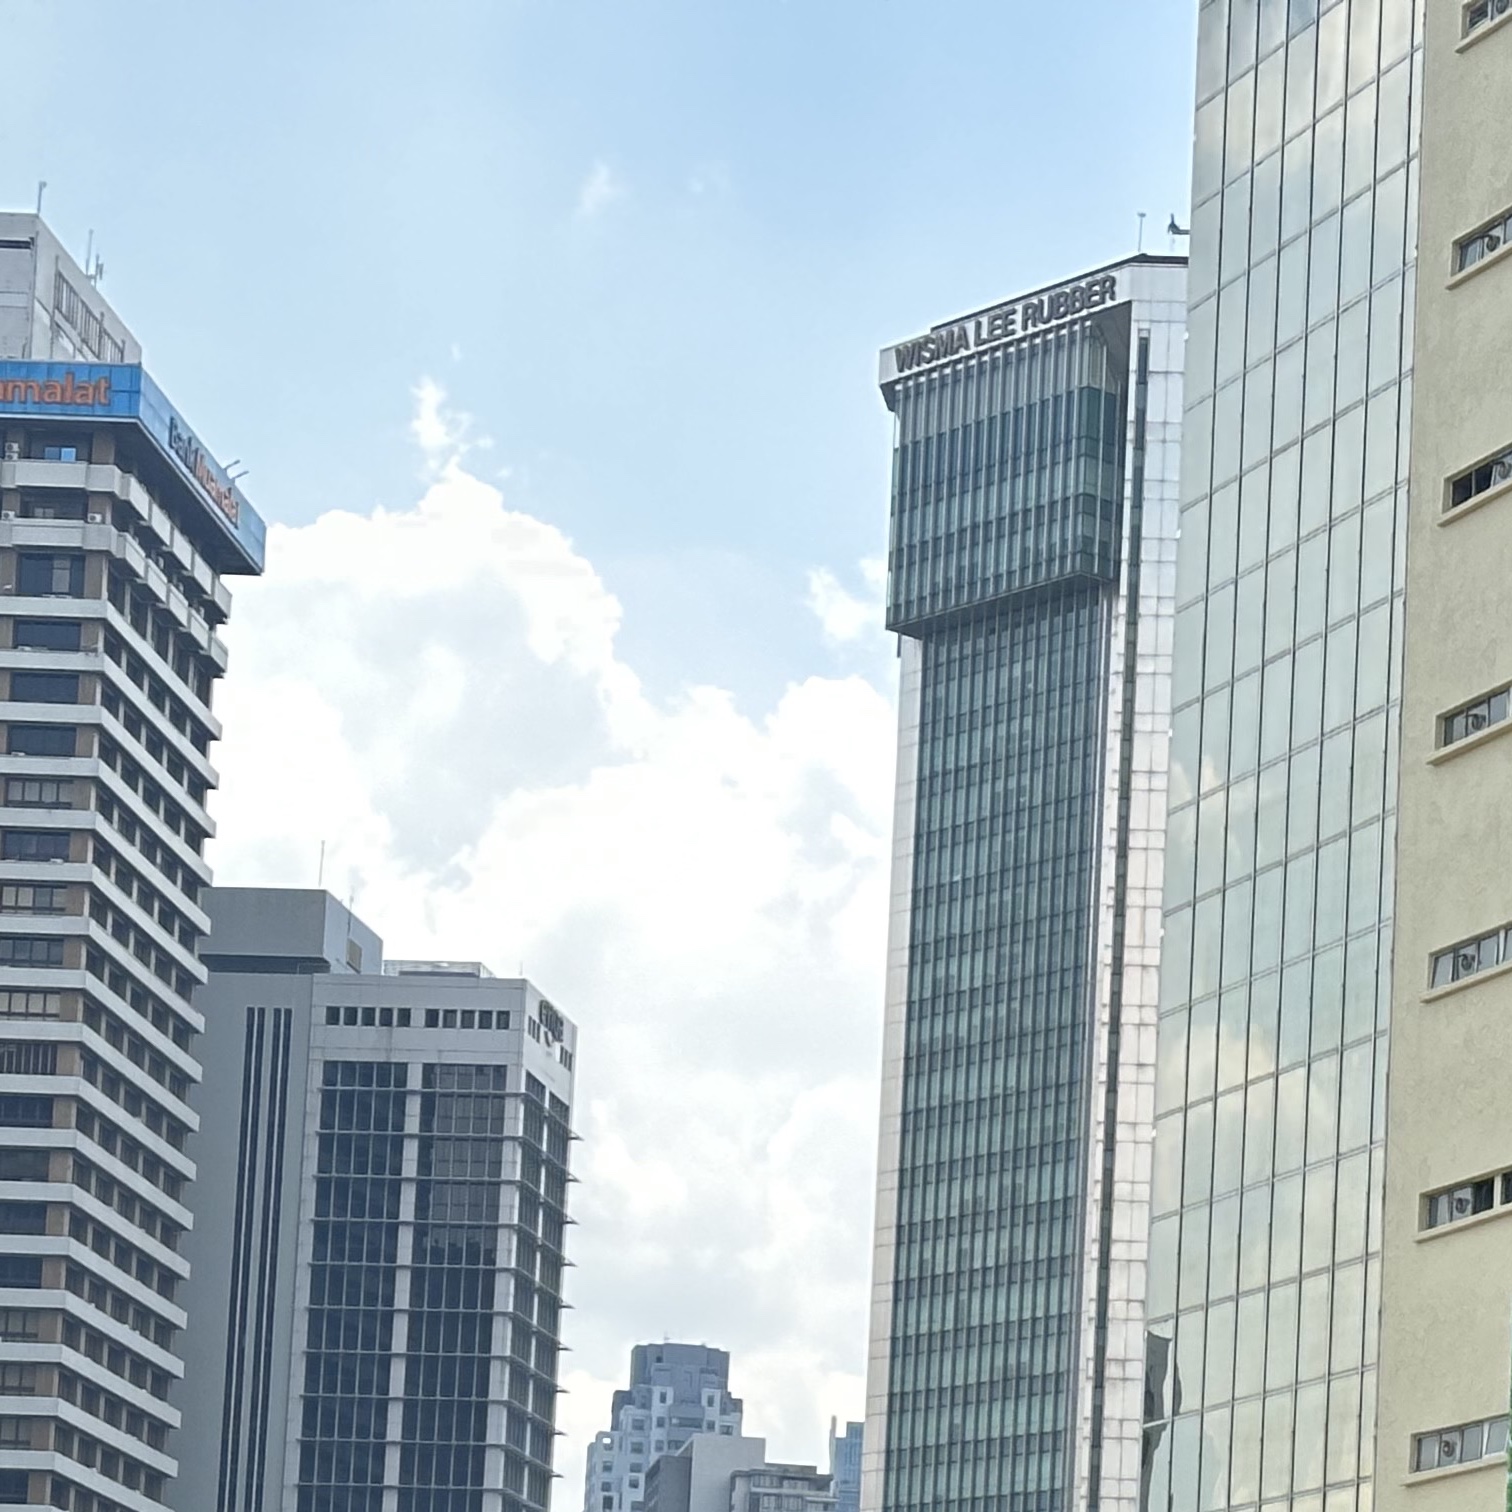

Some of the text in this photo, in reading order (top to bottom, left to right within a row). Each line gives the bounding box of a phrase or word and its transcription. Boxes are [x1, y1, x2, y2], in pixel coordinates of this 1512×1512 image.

[894, 274, 1117, 373] WISMA LEE RUBBER
